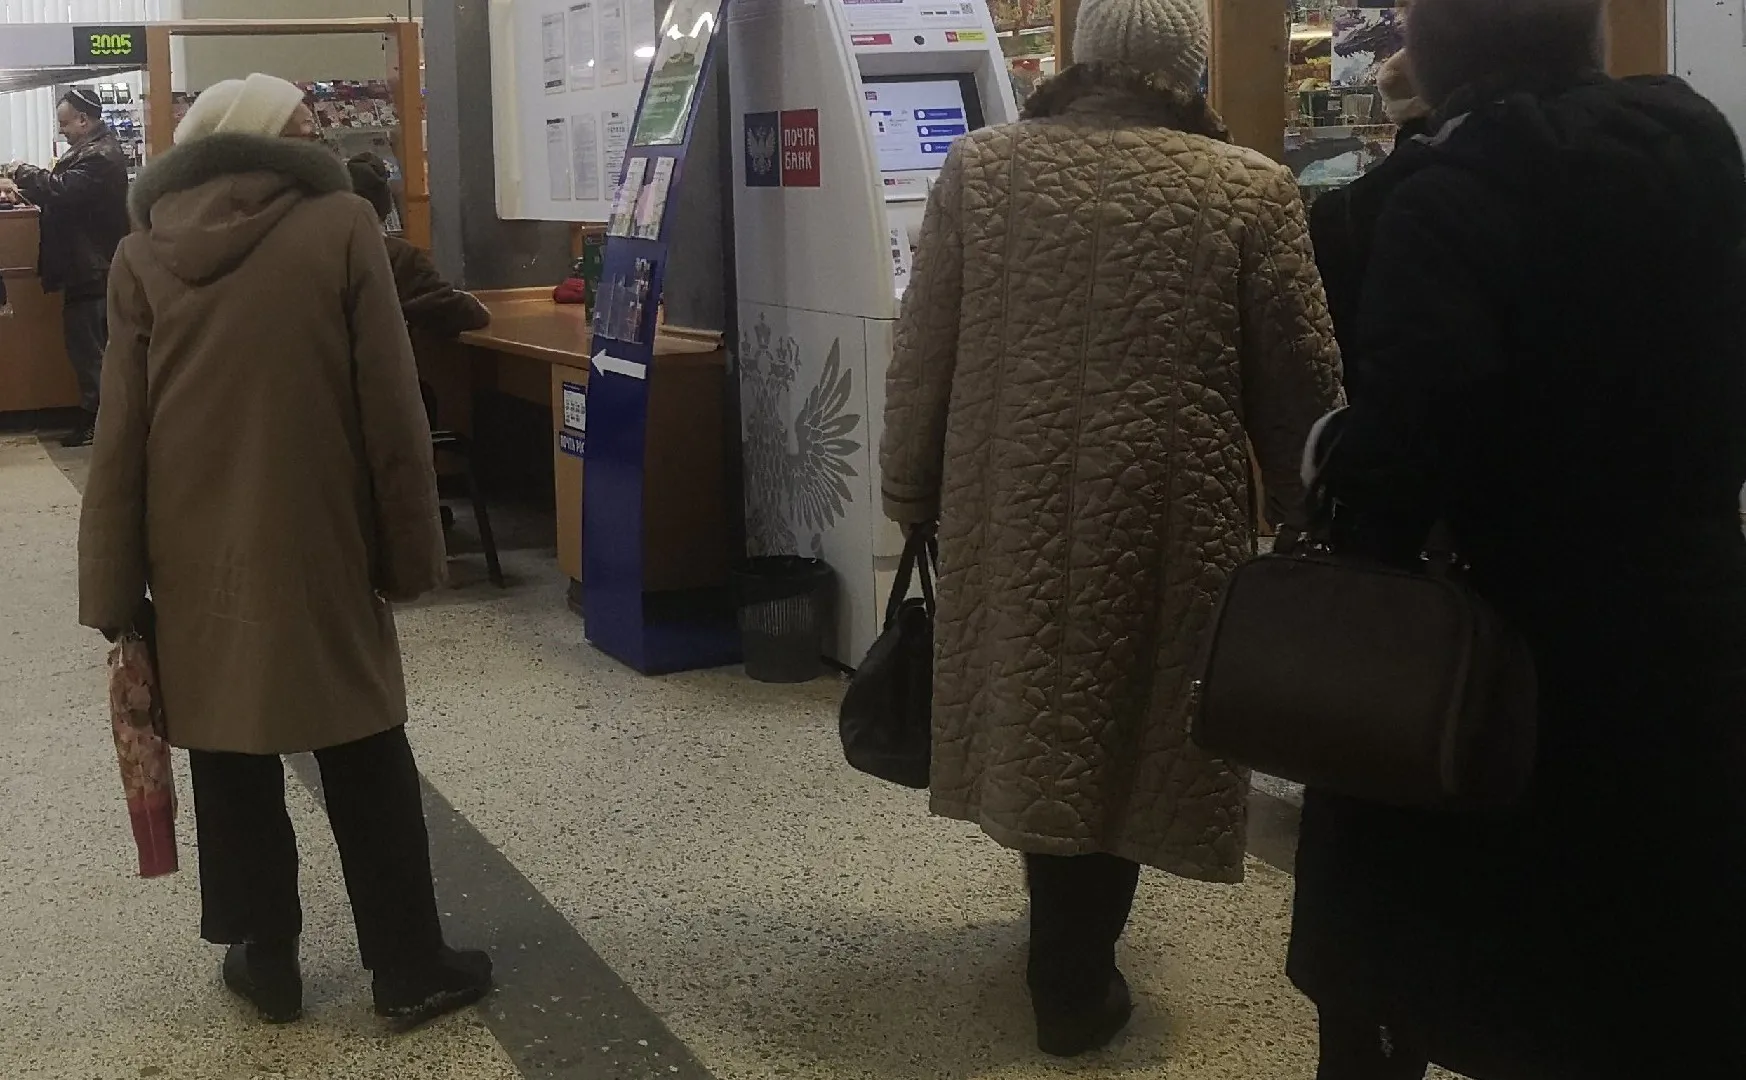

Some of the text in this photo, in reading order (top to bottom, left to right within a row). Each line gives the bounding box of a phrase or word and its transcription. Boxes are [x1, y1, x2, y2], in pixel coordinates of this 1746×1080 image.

[90, 34, 131, 55] 3005
[784, 127, 816, 147] ПОЧТА
[784, 151, 812, 170] БАНК
